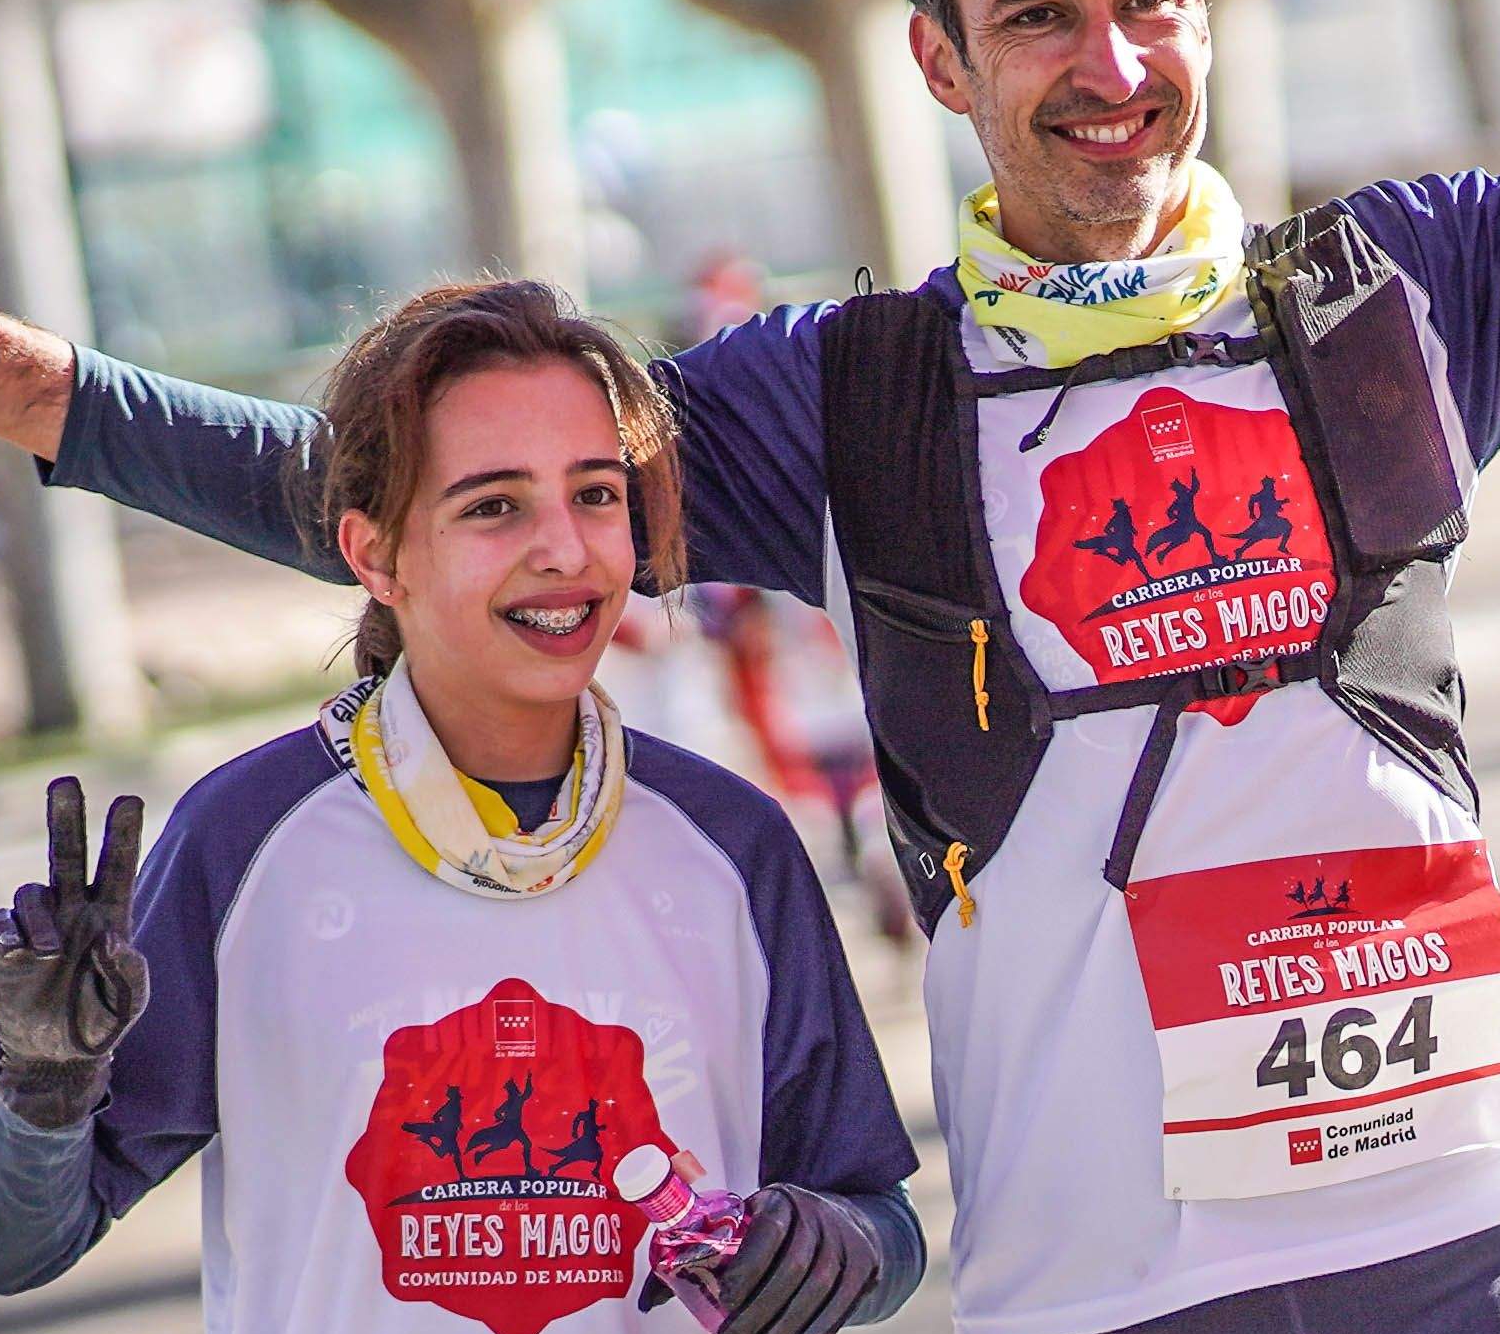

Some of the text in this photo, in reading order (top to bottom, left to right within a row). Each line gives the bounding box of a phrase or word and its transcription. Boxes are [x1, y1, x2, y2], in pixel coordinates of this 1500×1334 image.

[1112, 557, 1302, 608] CARRERA POPULAR
[1192, 589, 1223, 603] de los
[1100, 581, 1328, 667] REYES MAGOS
[1259, 640, 1318, 658] MADR
[1247, 919, 1406, 947] CARRERA POPULAR
[1313, 939, 1339, 949] de los
[1218, 932, 1451, 1008] REYES MAGOS
[1256, 995, 1438, 1098] 464
[1326, 1108, 1414, 1140] Comunidad
[1327, 1126, 1417, 1159] de Madrid
[421, 1180, 607, 1201] CARRERA POPULAR
[499, 1201, 529, 1211] de los
[401, 1213, 621, 1259] REYES MAGOS
[399, 1271, 517, 1286] COMUNIDAD
[525, 1271, 549, 1285] DE
